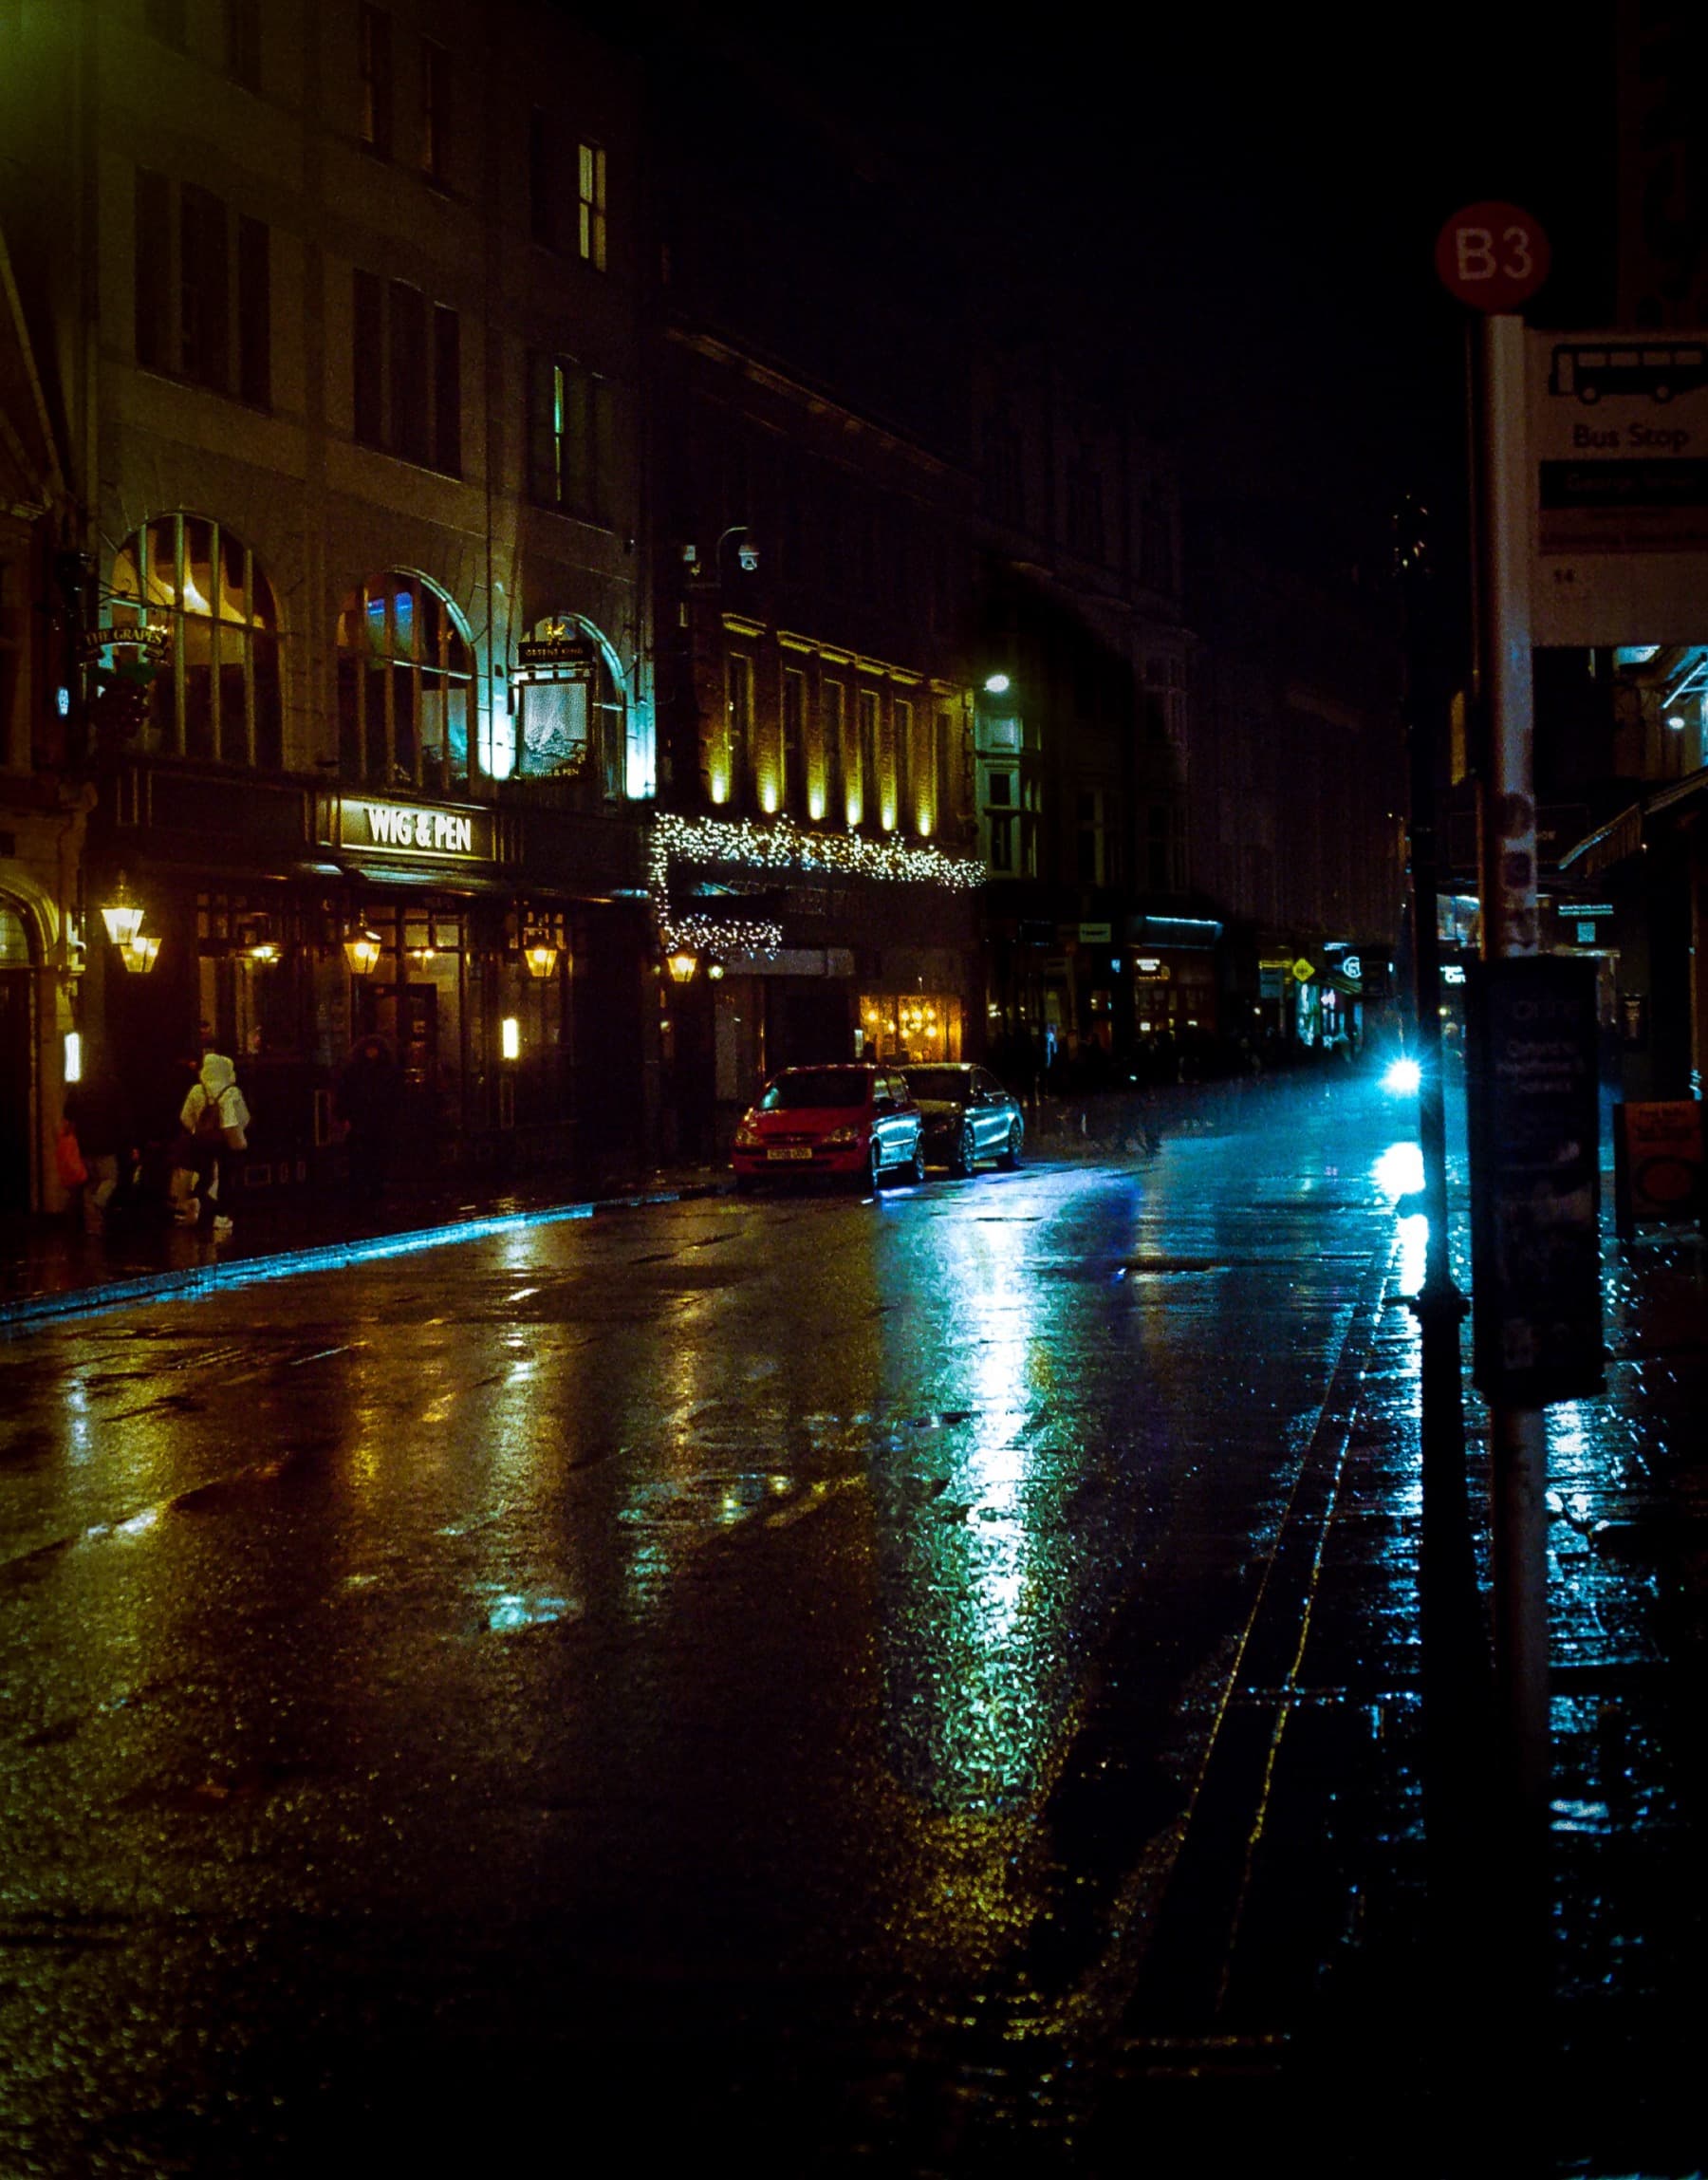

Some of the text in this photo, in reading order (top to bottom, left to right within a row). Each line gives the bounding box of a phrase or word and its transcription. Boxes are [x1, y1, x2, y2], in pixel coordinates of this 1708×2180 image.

[1455, 226, 1534, 282] B3
[1573, 422, 1689, 453] Bus Stop
[85, 628, 162, 645] THE GRAPES
[368, 806, 472, 851] WIG & PEN
